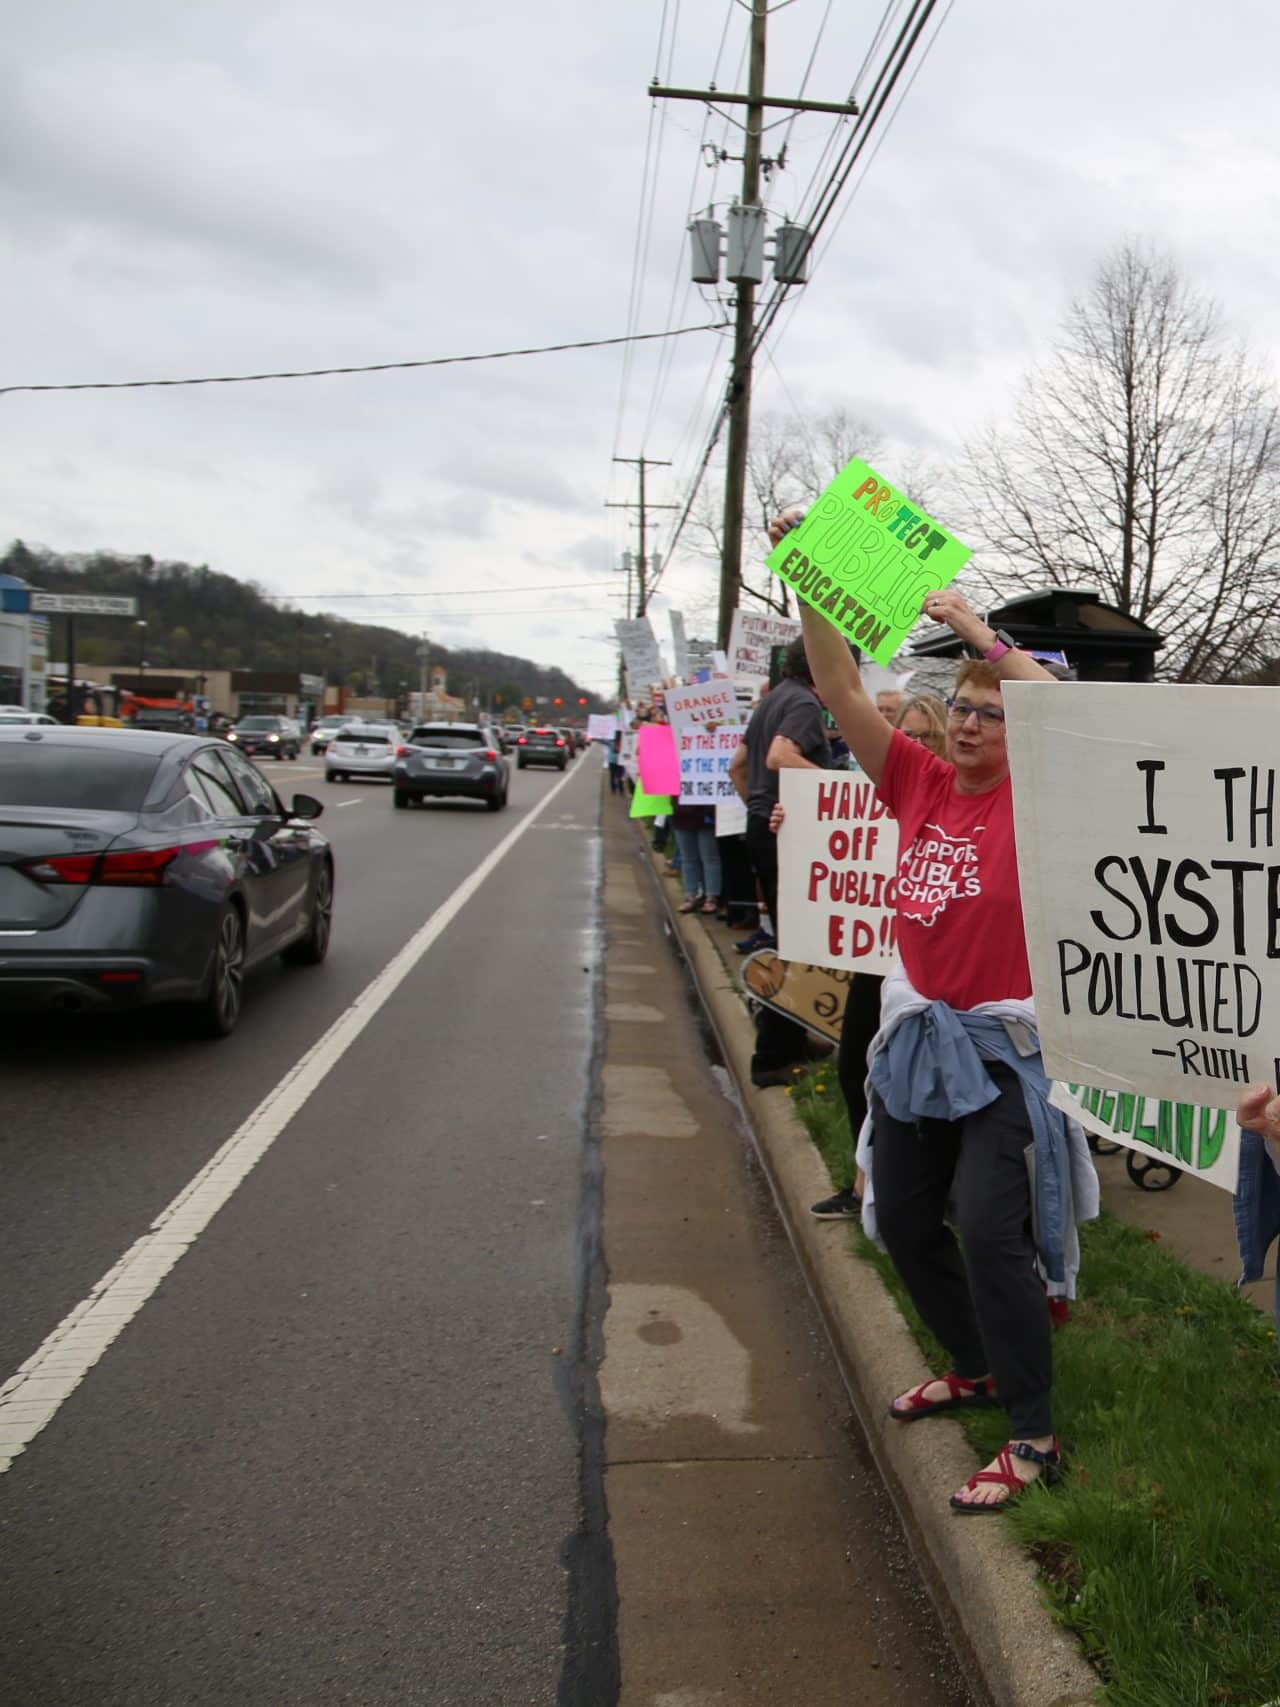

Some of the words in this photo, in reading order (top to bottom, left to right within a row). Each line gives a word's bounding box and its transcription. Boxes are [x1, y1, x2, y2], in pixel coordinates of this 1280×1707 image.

[852, 476, 948, 561] PROTECT
[791, 492, 943, 630] PUBLIC
[779, 547, 891, 653] EDUCATION
[674, 692, 730, 712] ORANGE
[690, 707, 725, 722] LIES
[696, 734, 715, 750] THE
[696, 758, 713, 773] THE
[697, 781, 713, 796] THE
[1136, 760, 1168, 834] I
[828, 826, 879, 861] OFF
[912, 838, 978, 862] UPPOR
[1058, 939, 1262, 1037] POLLUTED
